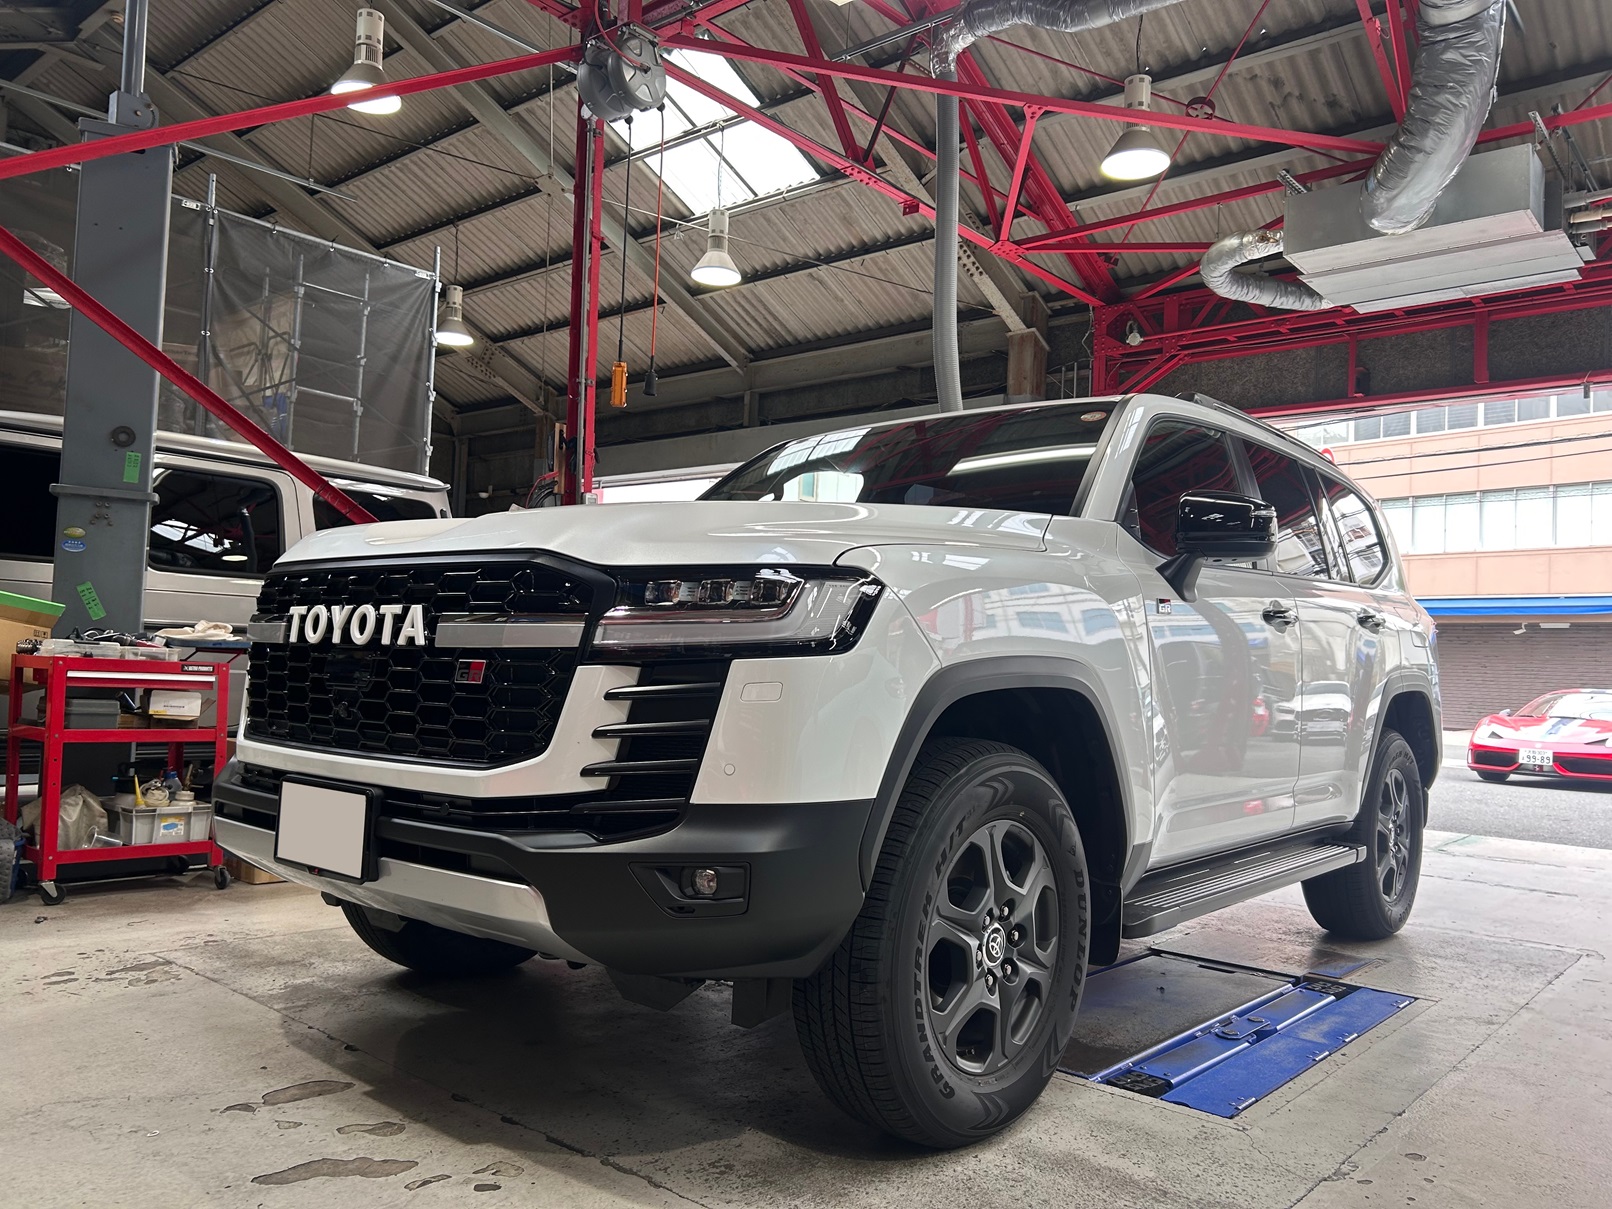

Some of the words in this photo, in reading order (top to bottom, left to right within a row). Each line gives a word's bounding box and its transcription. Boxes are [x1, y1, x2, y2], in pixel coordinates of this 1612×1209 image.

[1159, 604, 1171, 613] GR
[289, 604, 425, 646] TOYOTA
[457, 669, 482, 682] GR
[1526, 754, 1550, 764] 99-89
[1070, 868, 1088, 1013] DUNLOP
[913, 891, 956, 1100] GRANDTREK
[935, 814, 967, 880] H/T
